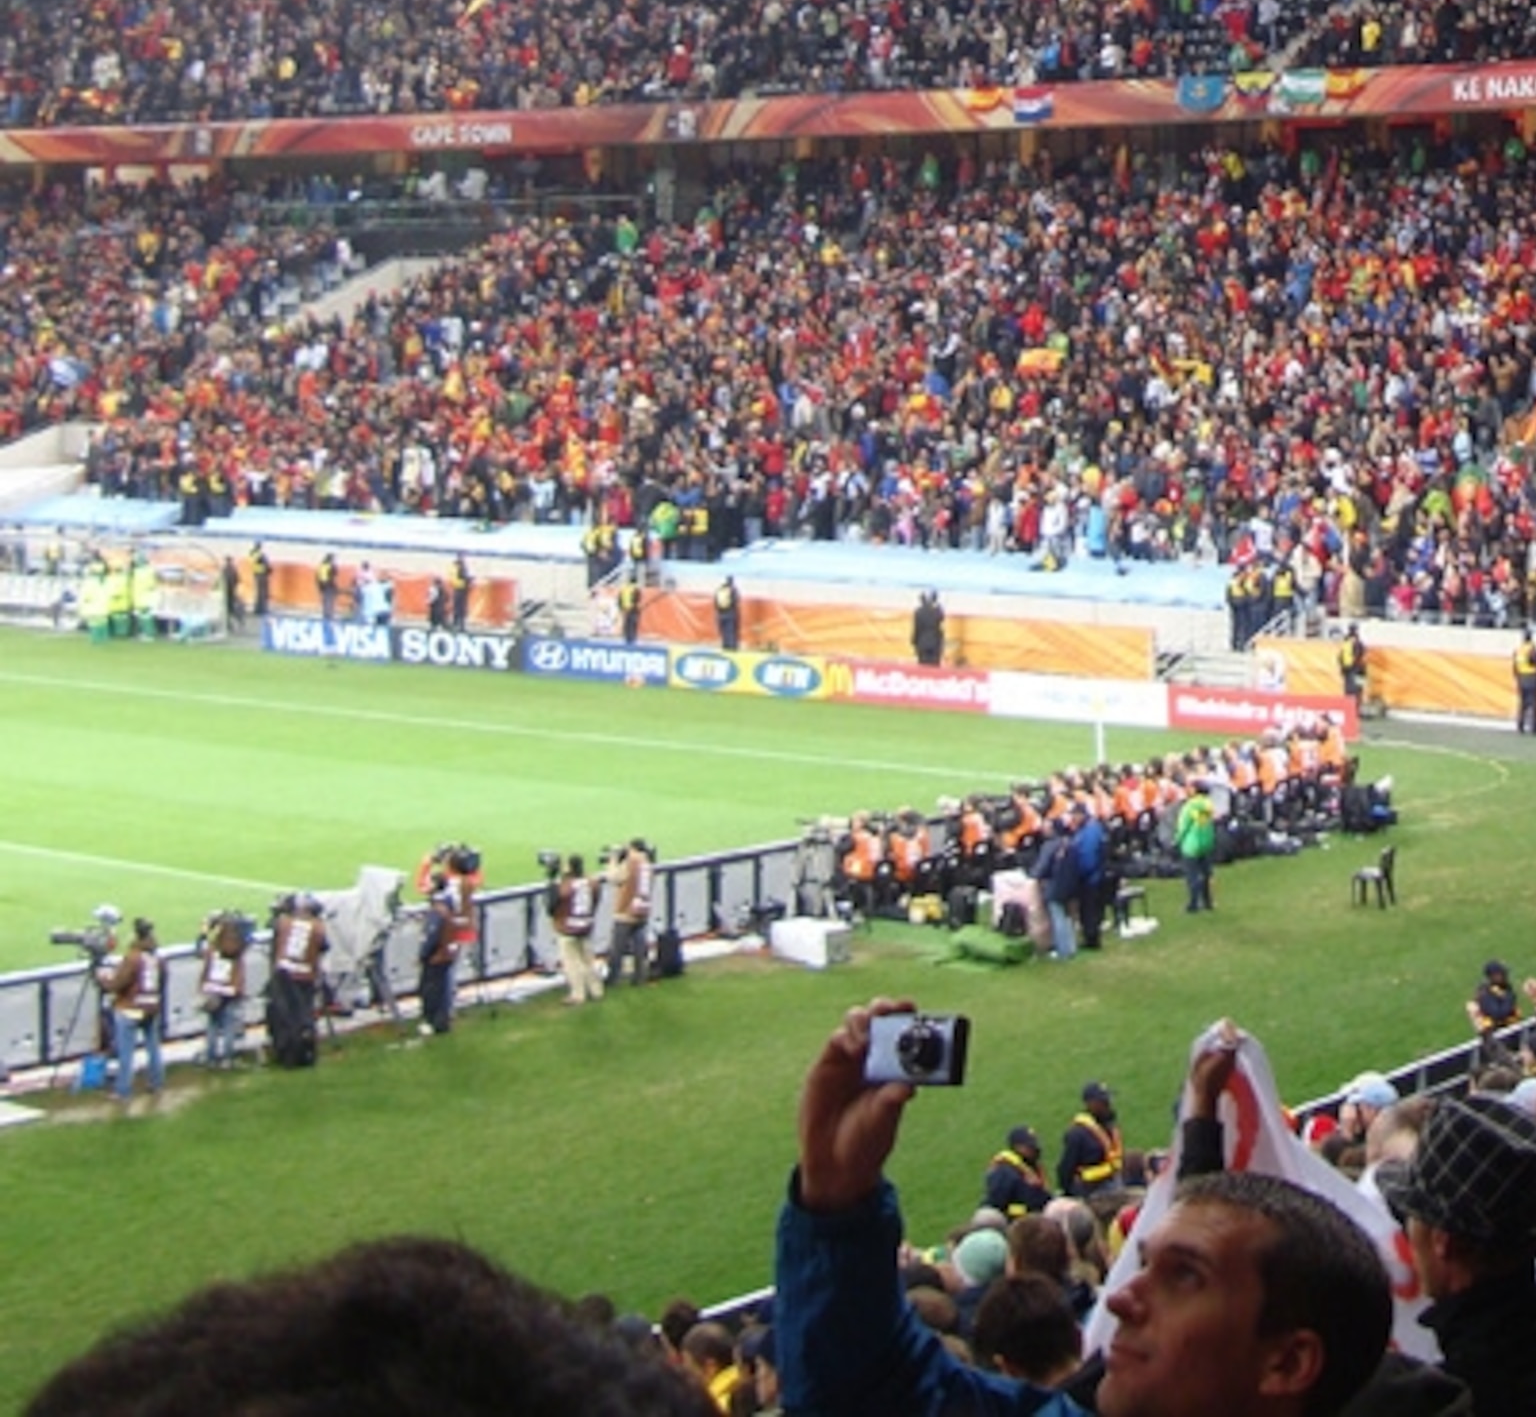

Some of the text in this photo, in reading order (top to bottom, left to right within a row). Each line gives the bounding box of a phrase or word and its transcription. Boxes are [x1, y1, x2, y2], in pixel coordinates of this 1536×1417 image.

[1451, 76, 1481, 101] KE
[411, 123, 512, 144] CAPE TOWN
[271, 619, 325, 654] VISA
[334, 623, 390, 658] VISA
[400, 629, 514, 669] SONY
[571, 648, 666, 675] HYUNDAI
[682, 656, 731, 680] MTN
[763, 663, 812, 688] MTN
